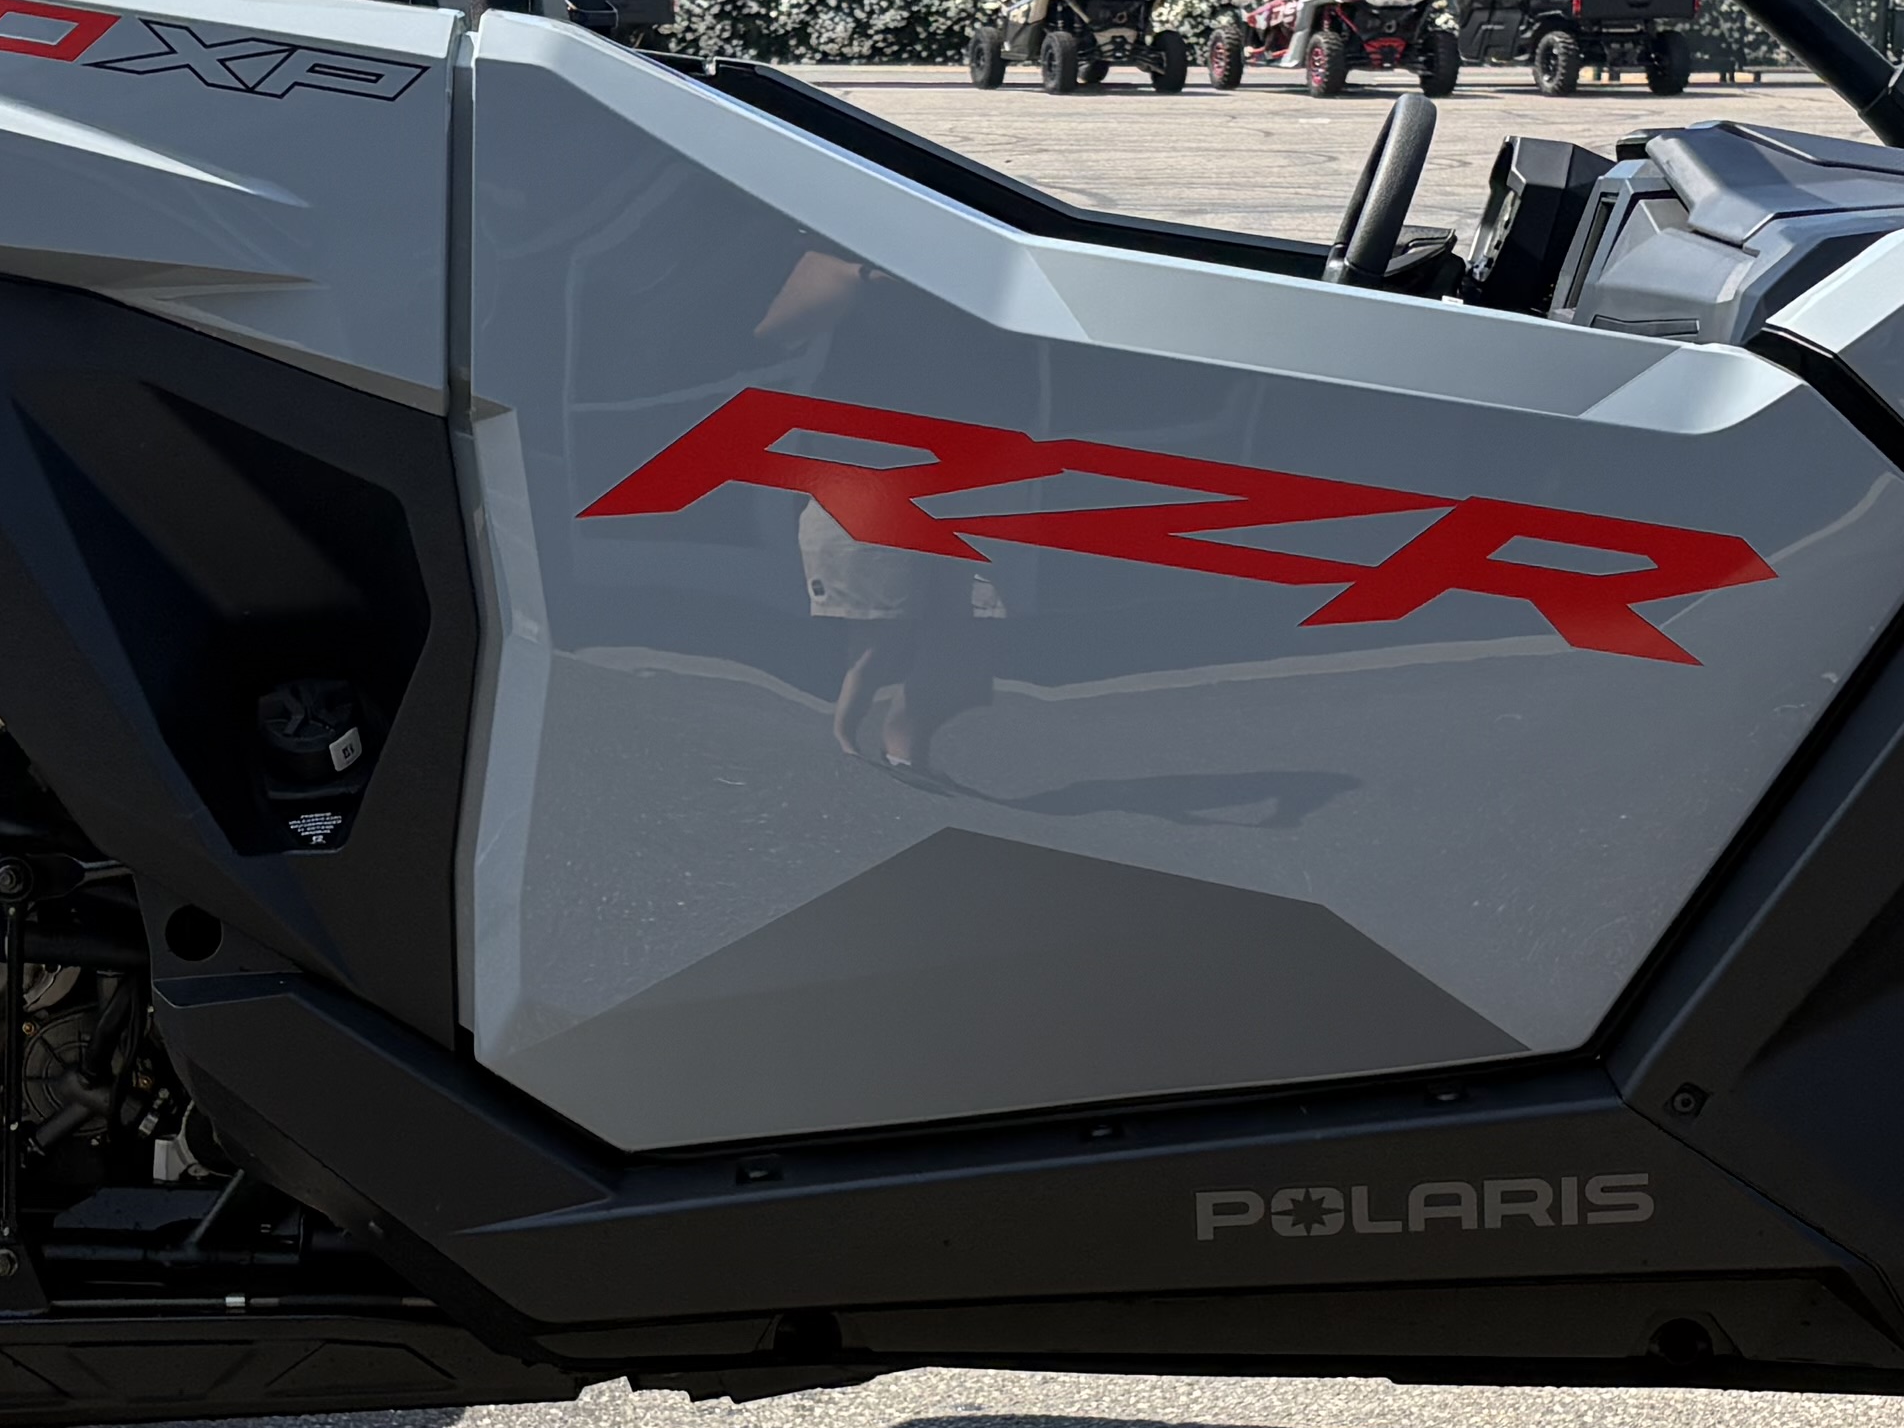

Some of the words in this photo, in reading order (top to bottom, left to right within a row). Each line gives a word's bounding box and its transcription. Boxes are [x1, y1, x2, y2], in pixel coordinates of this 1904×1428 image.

[84, 19, 432, 102] XP
[575, 387, 1778, 666] RZR
[1195, 1172, 1656, 1241] POLARIS
